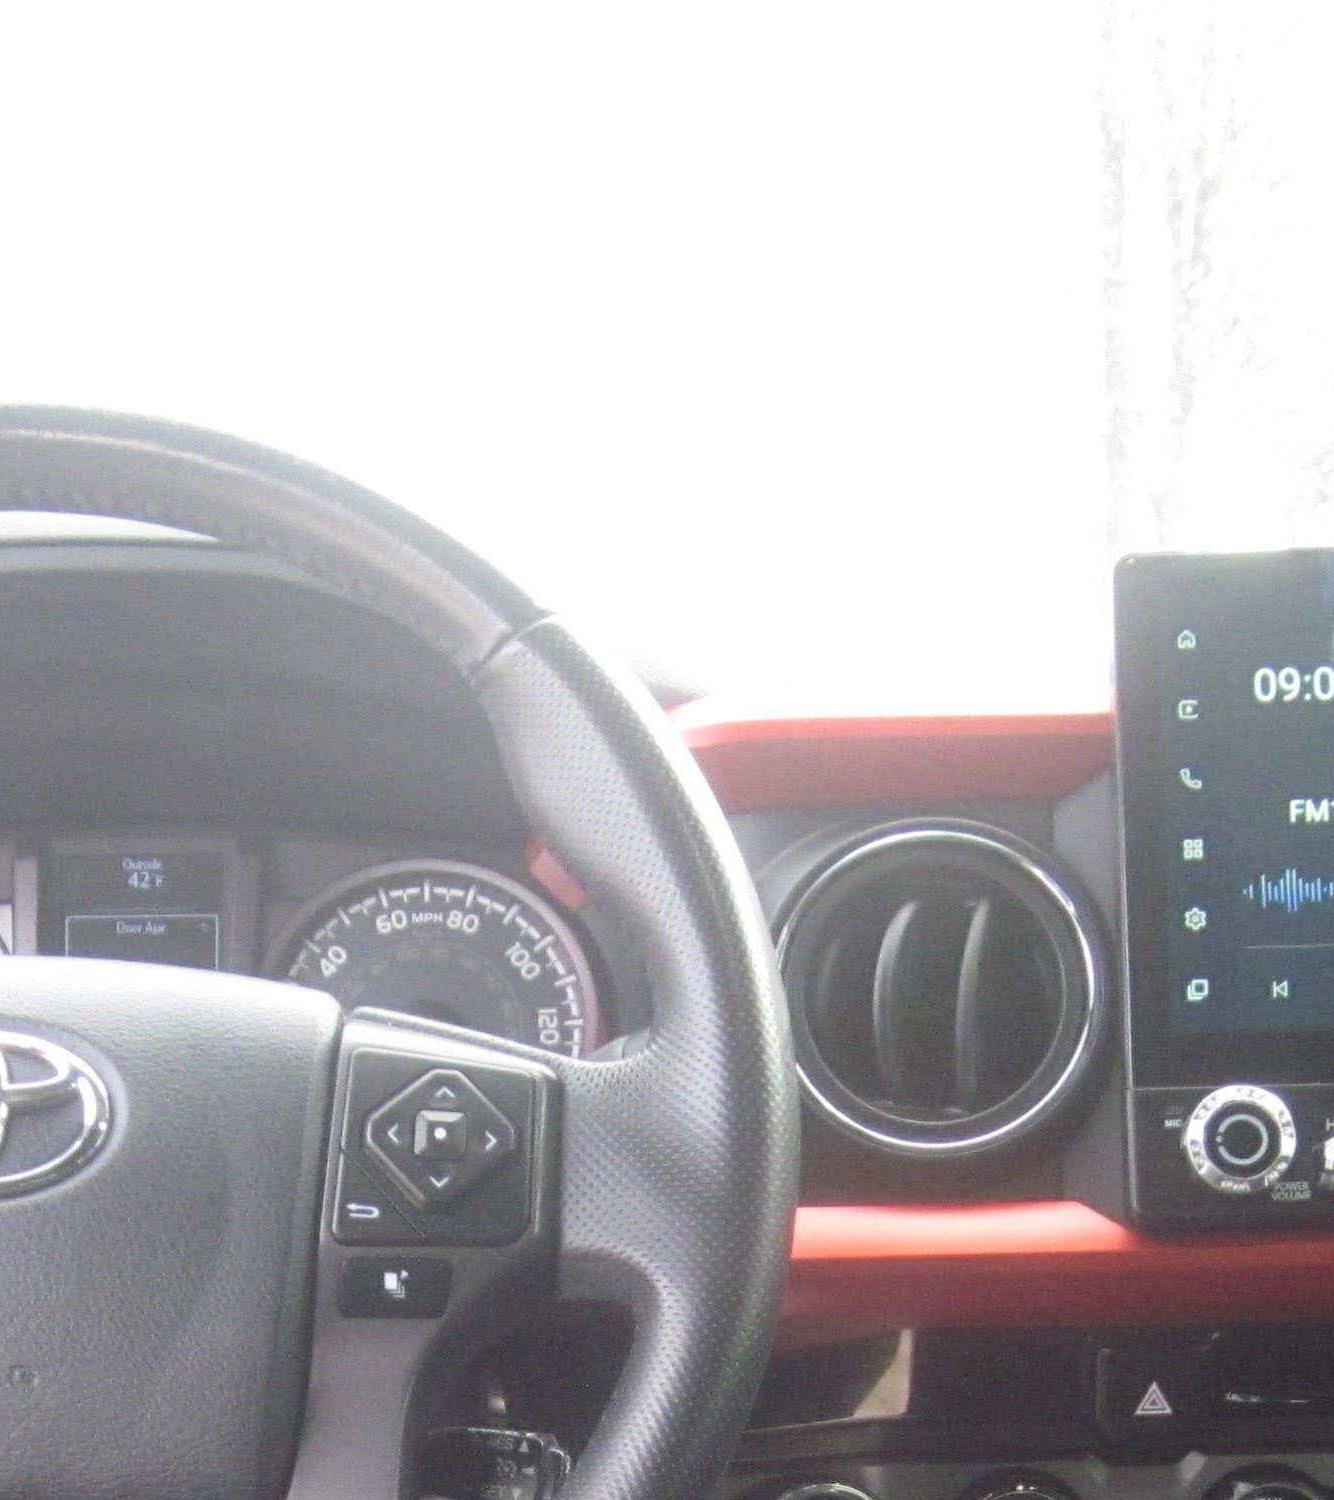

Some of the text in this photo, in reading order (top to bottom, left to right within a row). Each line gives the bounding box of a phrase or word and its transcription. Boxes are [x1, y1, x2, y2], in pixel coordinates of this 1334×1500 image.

[374, 909, 408, 934] 60
[411, 912, 443, 924] MPH
[446, 909, 480, 934] 80
[320, 944, 347, 978] 40
[504, 942, 541, 981] 100
[537, 1006, 561, 1045] 120
